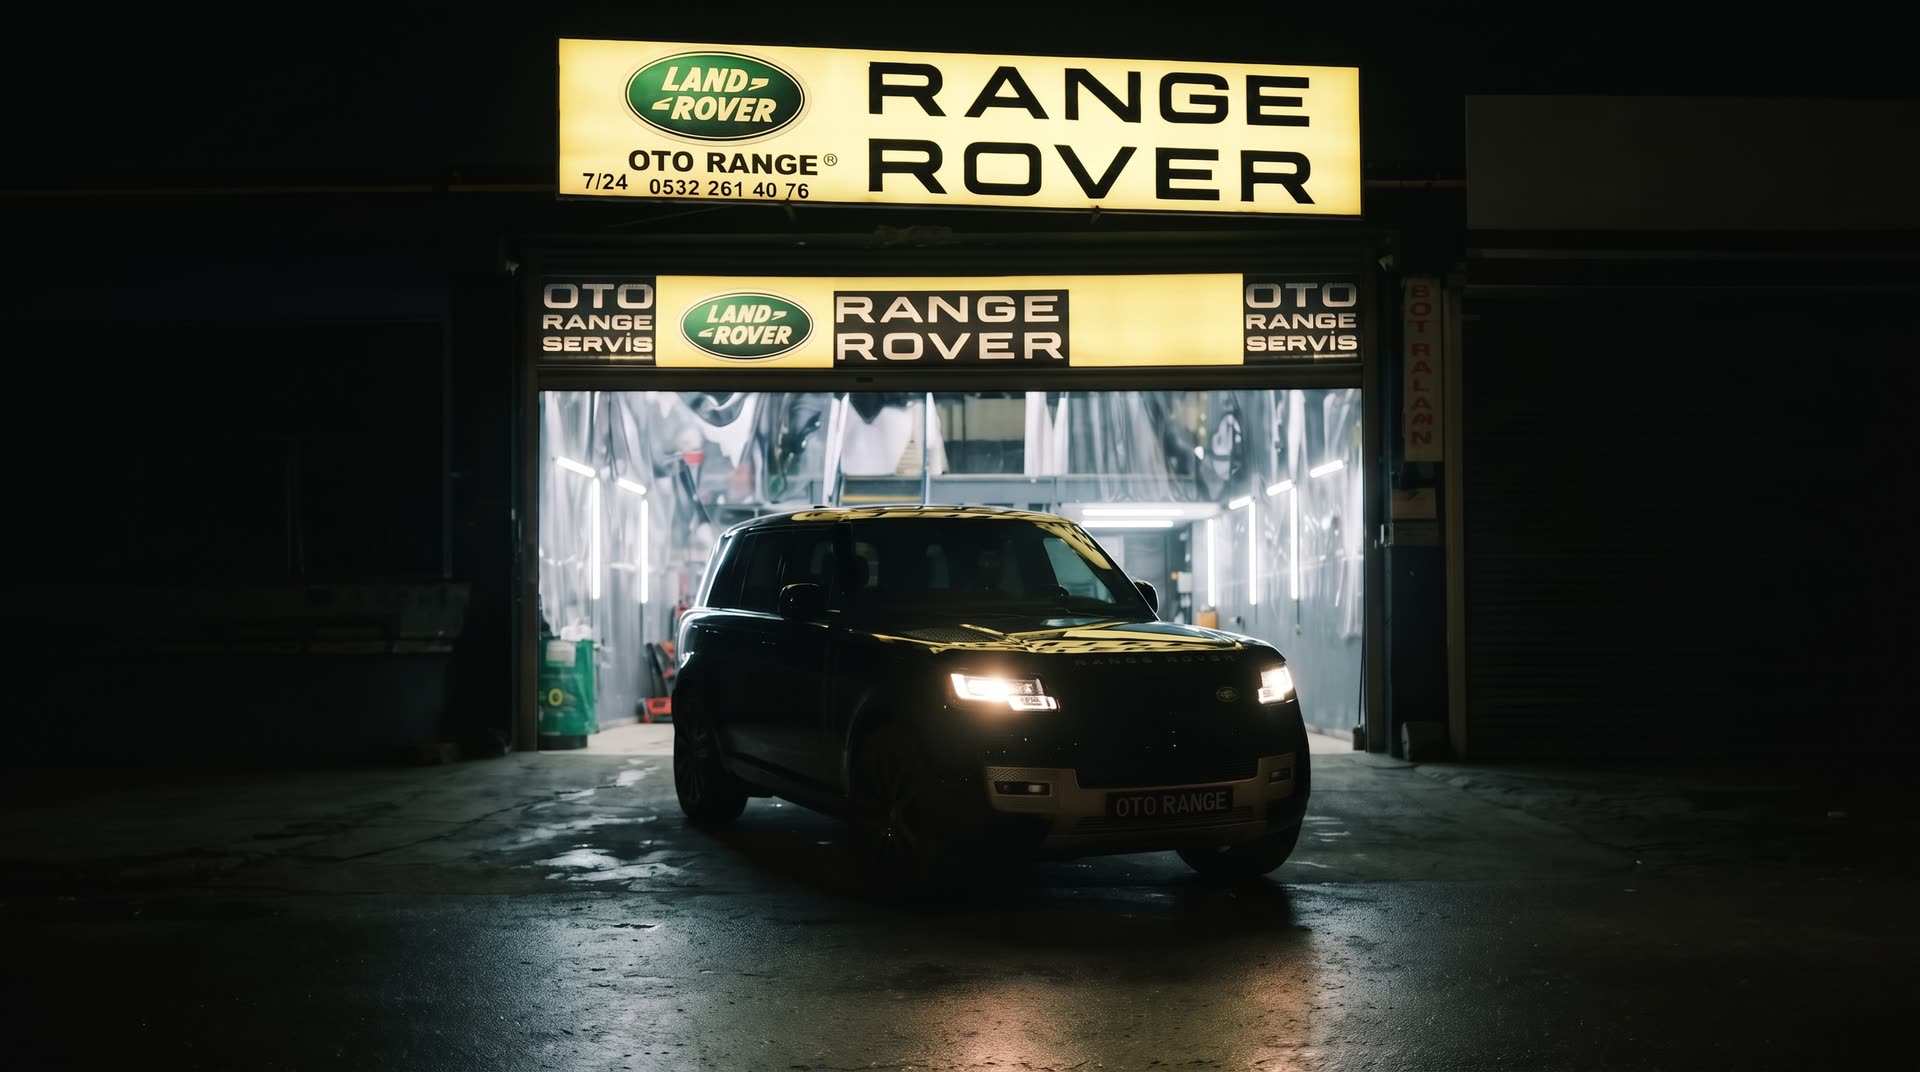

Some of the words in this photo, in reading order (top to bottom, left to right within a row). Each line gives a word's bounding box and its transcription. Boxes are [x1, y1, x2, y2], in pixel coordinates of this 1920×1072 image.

[661, 66, 748, 92] LAND
[868, 62, 1310, 127] RANGE
[671, 97, 777, 123] ROVER
[629, 150, 693, 172] OTO
[707, 152, 817, 175] RANGE
[868, 138, 1316, 205] ROVER
[583, 173, 628, 190] 7/24
[649, 178, 700, 196] 0532
[708, 181, 743, 197] 261
[753, 182, 777, 198] 40
[785, 183, 809, 199] 76
[544, 284, 653, 309] OTO
[1246, 283, 1356, 308] OTO
[543, 315, 653, 330] RANGE
[706, 303, 771, 323] LAND
[836, 296, 1059, 323] RANGE
[1246, 313, 1356, 329] RANGE
[713, 325, 792, 345] ROVER
[837, 332, 1063, 360] ROVER
[1116, 796, 1156, 817] OTO
[1163, 791, 1227, 815] RANGE
